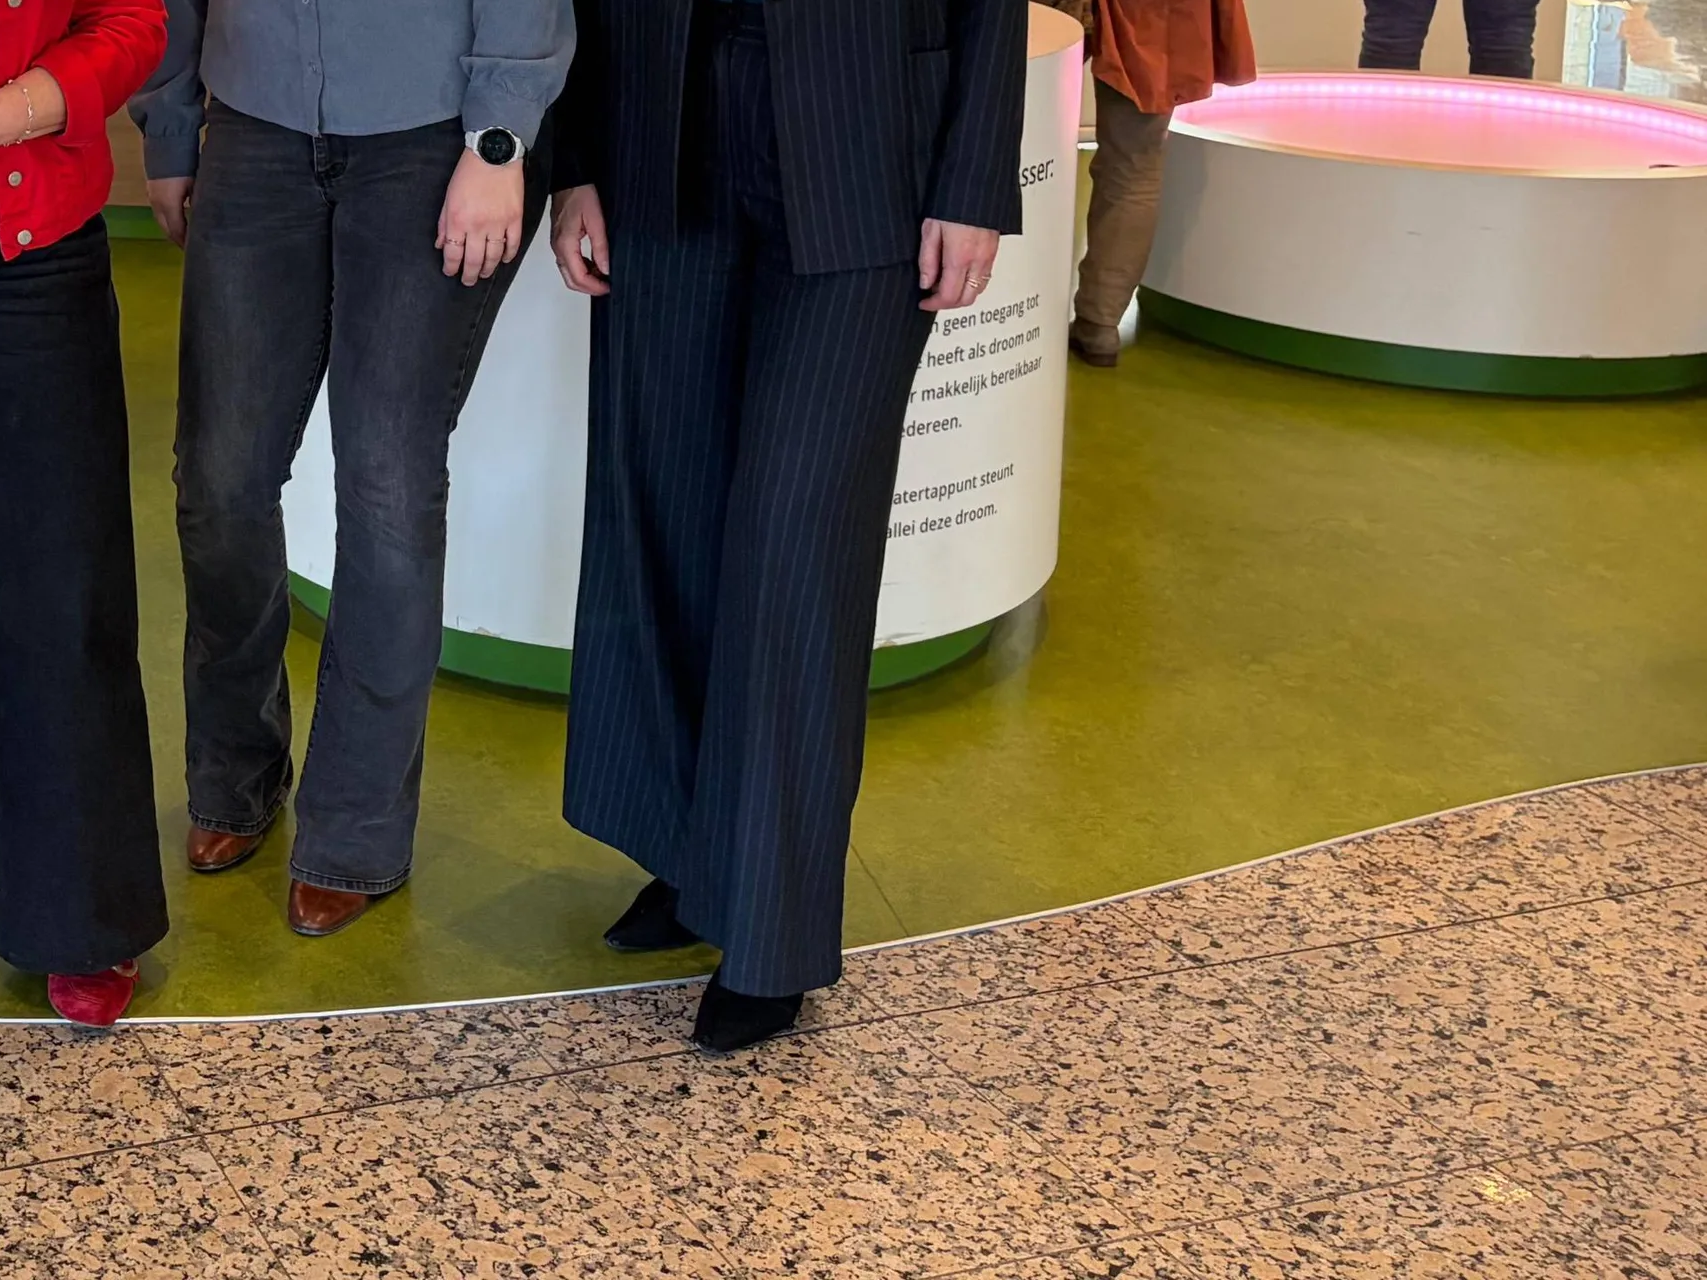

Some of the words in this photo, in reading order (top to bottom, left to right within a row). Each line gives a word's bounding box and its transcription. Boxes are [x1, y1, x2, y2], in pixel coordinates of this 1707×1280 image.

[1021, 159, 1054, 187] sser:
[943, 313, 977, 336] geen
[980, 300, 1025, 324] toegang
[1026, 293, 1040, 311] tot
[927, 346, 965, 368] heeft
[967, 341, 987, 360] als
[989, 332, 1024, 355] droom
[1026, 325, 1041, 343] om
[921, 373, 988, 402] makkelijk
[991, 355, 1043, 387] bereikbaar
[901, 416, 963, 438] edereen.
[893, 475, 979, 506] atertappunt
[980, 462, 1014, 487] steunt
[886, 519, 916, 539] allei
[919, 515, 953, 533] deze
[955, 502, 998, 525] droom.
